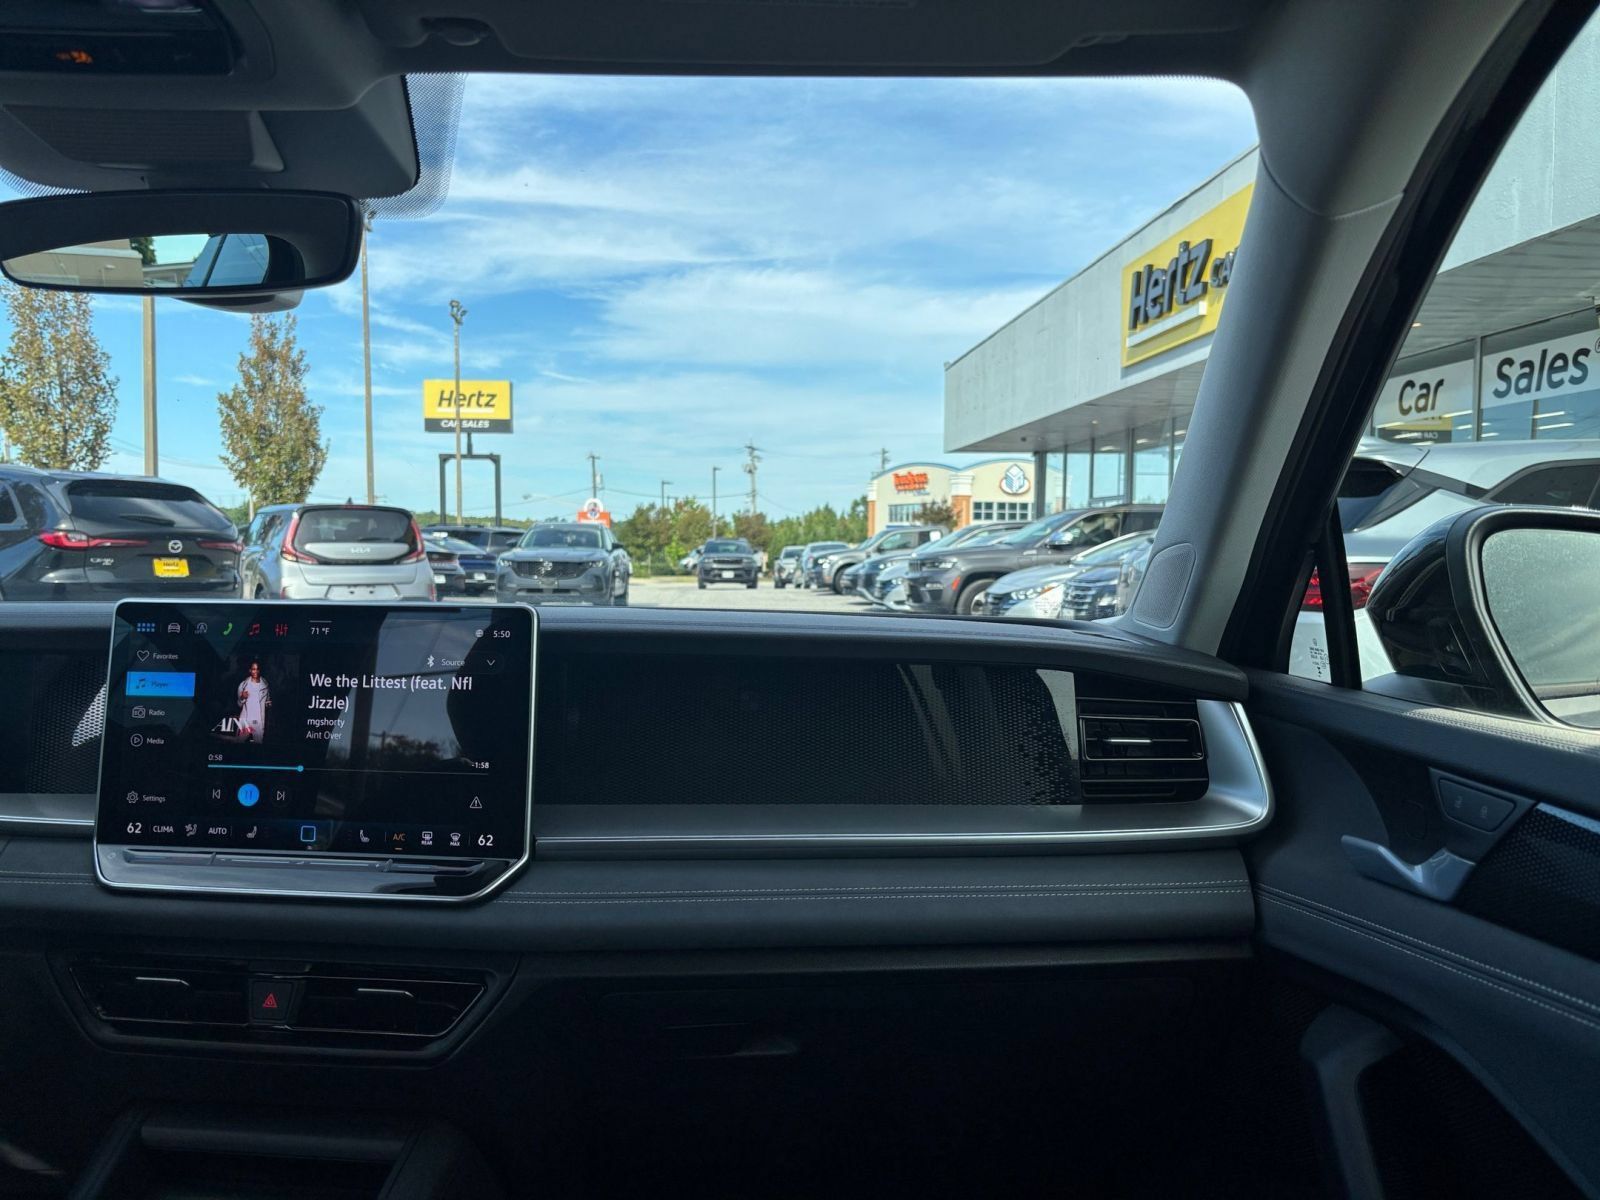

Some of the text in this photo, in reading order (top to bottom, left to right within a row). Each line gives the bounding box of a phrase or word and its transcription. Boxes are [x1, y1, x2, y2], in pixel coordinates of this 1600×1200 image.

[1128, 239, 1239, 331] Hertz CA
[1398, 347, 1591, 417] Car Sales
[438, 390, 497, 408] Hertz
[461, 420, 489, 428] SALES
[311, 627, 320, 635] 71
[493, 630, 510, 638] 5:50
[152, 652, 179, 661] Favorites
[441, 658, 465, 667] Source
[310, 674, 473, 692] We the Littest (feat. Nfl
[308, 696, 350, 712] Jizzle)
[148, 708, 166, 716] Radio
[307, 718, 345, 729] mgshorty
[306, 731, 342, 740] Aint Over
[142, 794, 166, 803] Settings
[127, 822, 142, 834] 62
[152, 825, 174, 833] CLIMA
[208, 827, 227, 835] AUTO
[392, 833, 405, 841] A/C
[478, 834, 493, 846] 62
